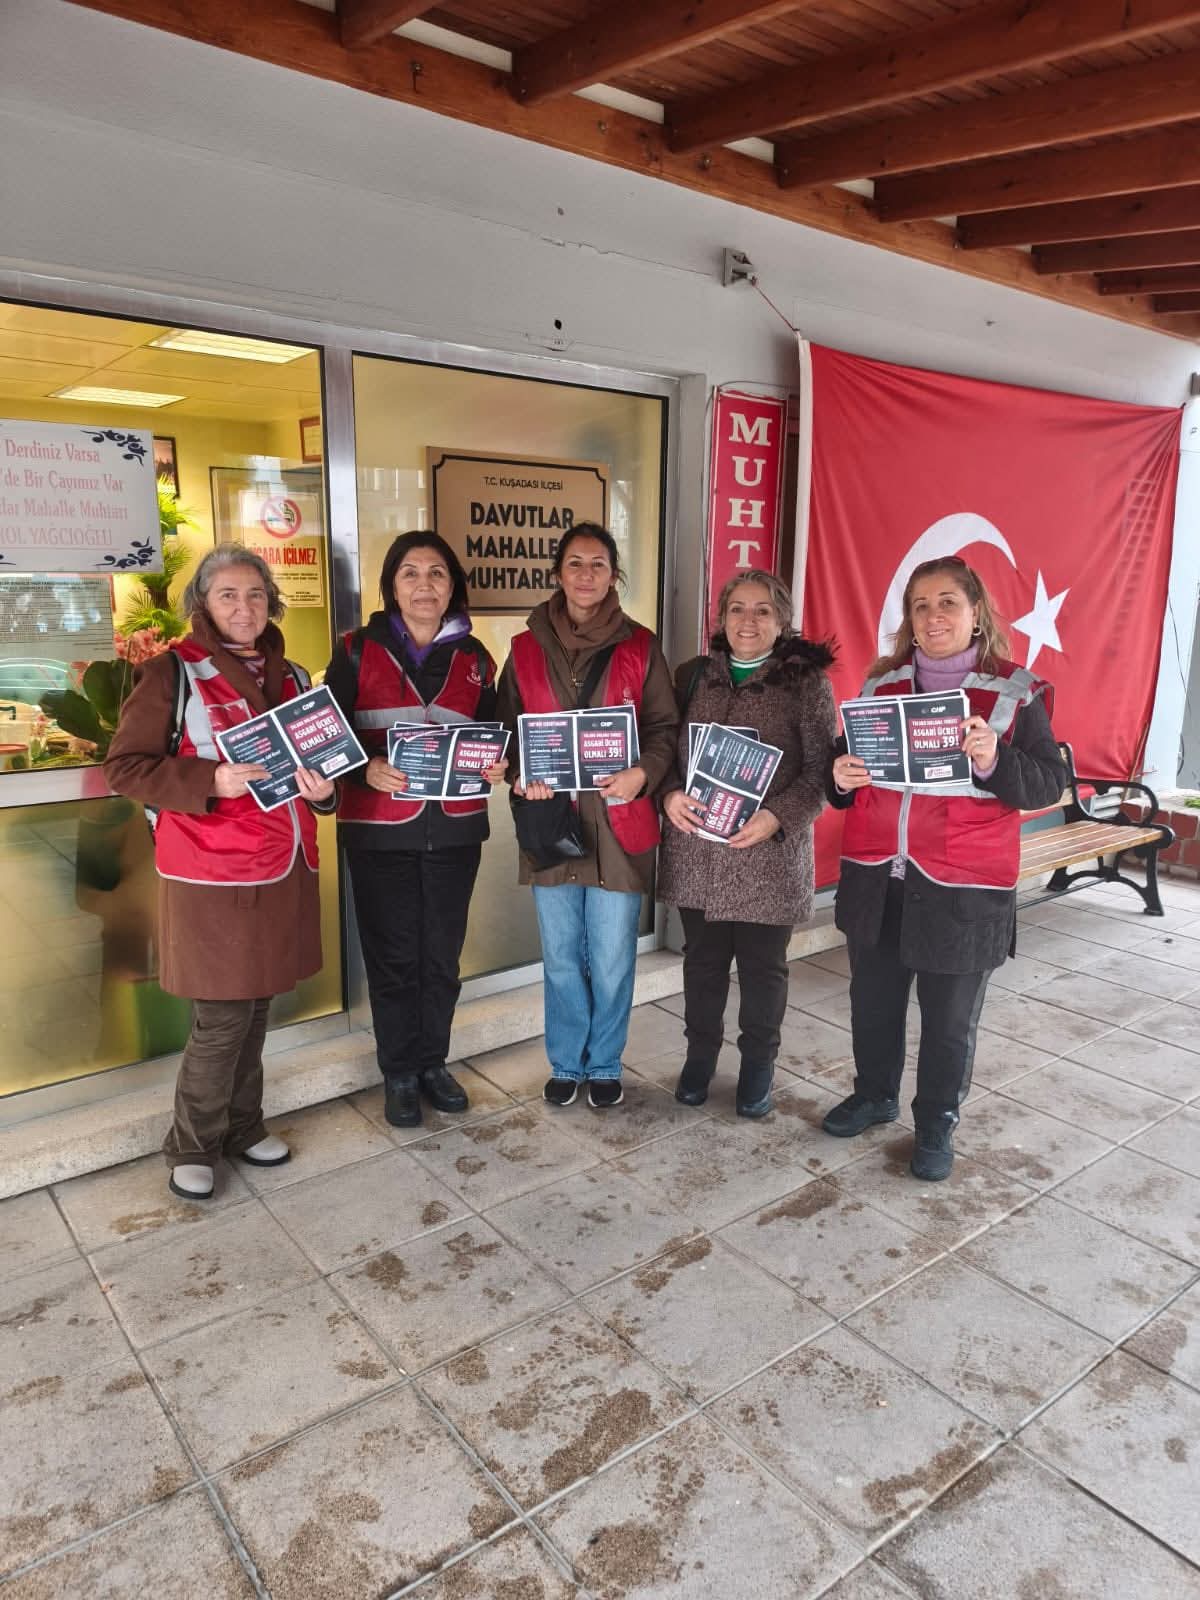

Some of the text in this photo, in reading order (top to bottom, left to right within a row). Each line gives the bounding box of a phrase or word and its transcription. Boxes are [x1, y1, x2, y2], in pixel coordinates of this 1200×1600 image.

[5, 439, 101, 462] Derdiniz Varsa
[24, 469, 43, 488] Bir
[104, 474, 123, 491] Var
[500, 478, 539, 489] KUŞADASI
[541, 479, 563, 492] İLÇESİ
[24, 498, 75, 517] Mahalle
[80, 500, 127, 520] Muhtarı
[471, 502, 574, 529] DAVUTLAR
[283, 543, 317, 568] İÇİLMEZ
[942, 735, 959, 748] 39!
